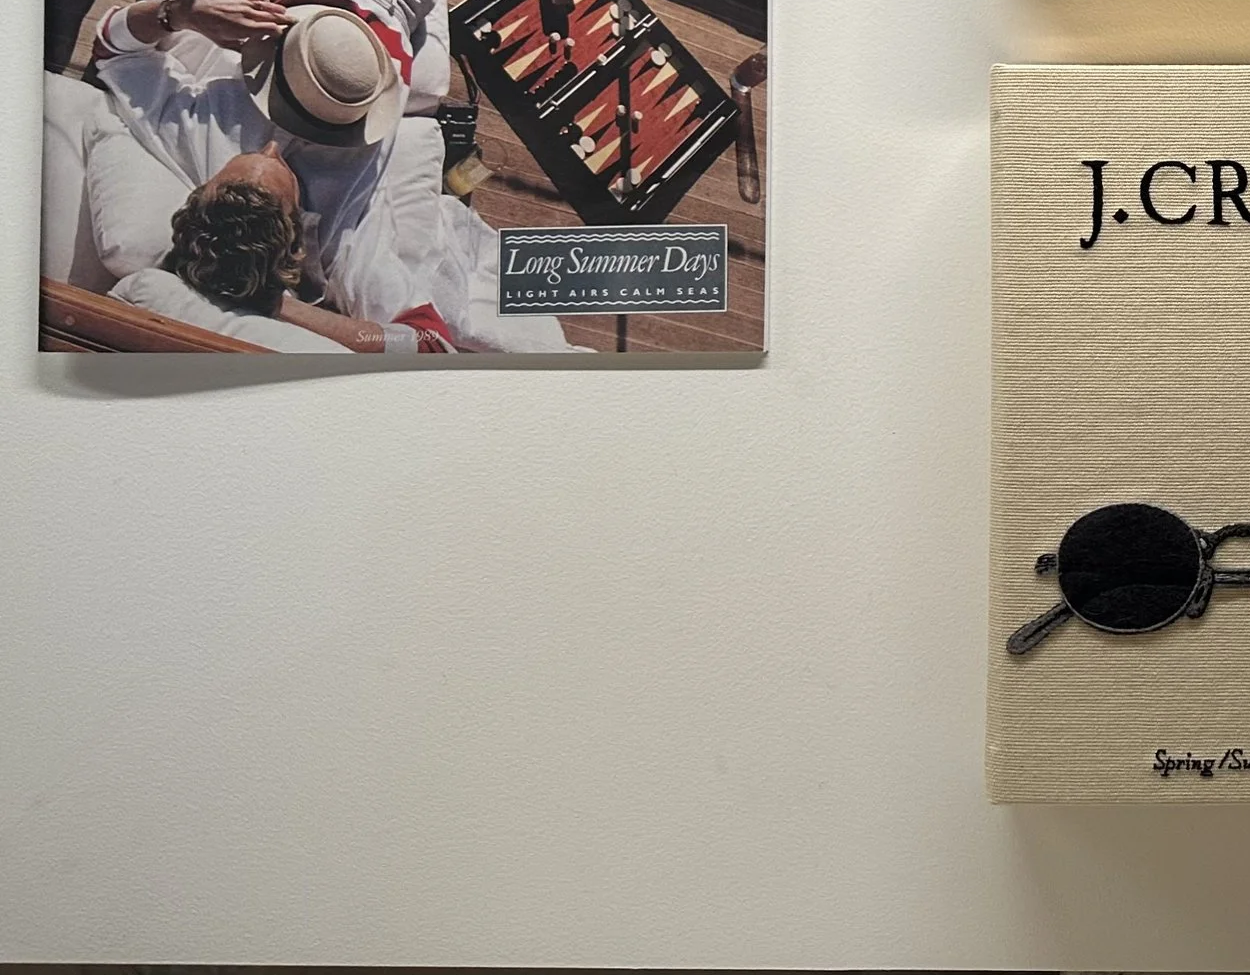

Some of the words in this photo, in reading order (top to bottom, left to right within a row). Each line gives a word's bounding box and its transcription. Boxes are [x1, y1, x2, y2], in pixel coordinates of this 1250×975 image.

[505, 248, 564, 285] Long
[566, 247, 660, 275] Summer
[660, 246, 721, 281] Days
[505, 288, 560, 299] LIGHT
[568, 287, 610, 298] AIRS
[619, 287, 667, 297] CALM
[676, 286, 721, 296] SEAS
[355, 328, 406, 343] Summer
[410, 328, 439, 343] 1989
